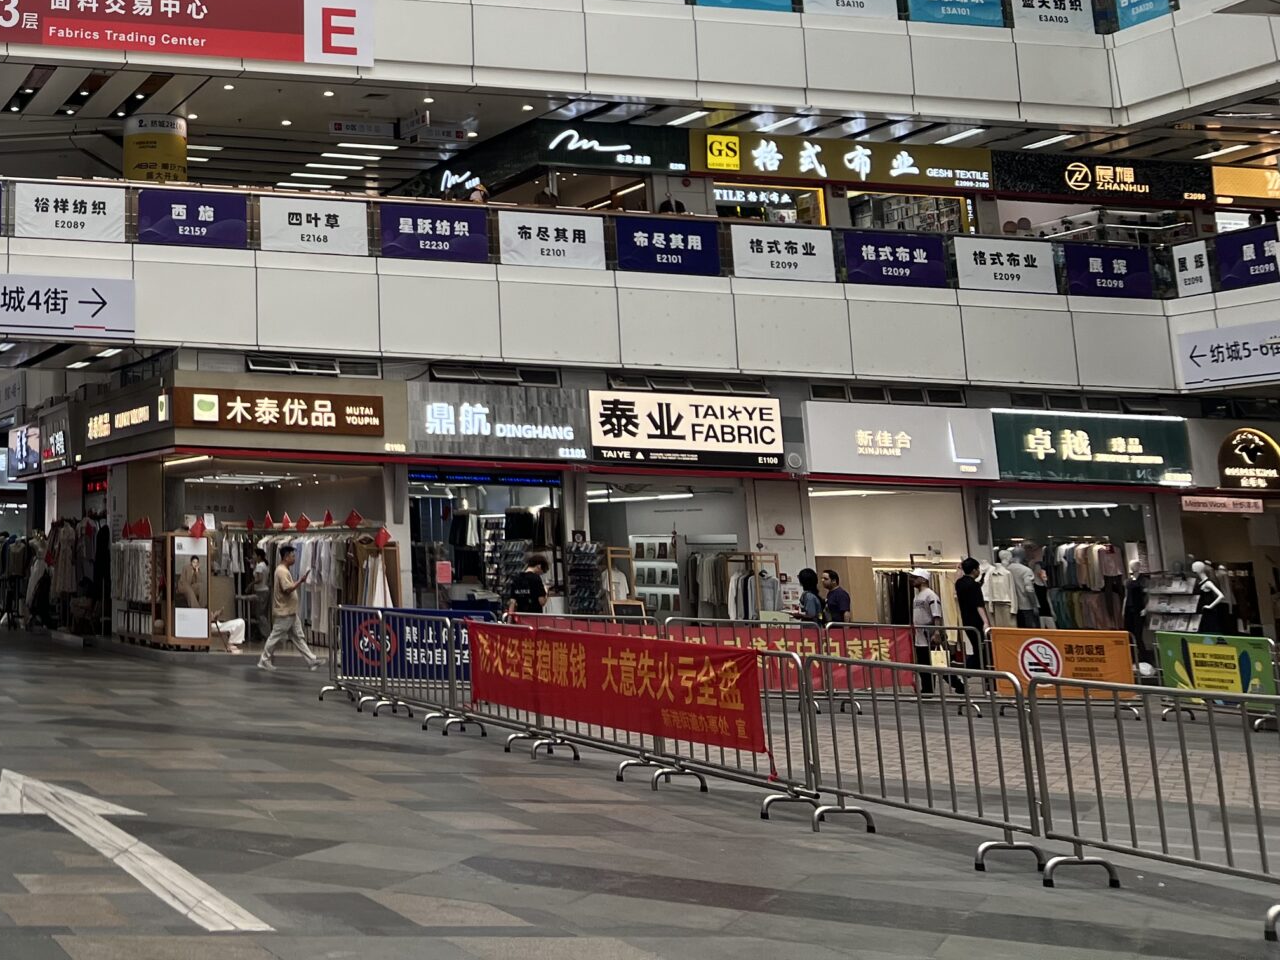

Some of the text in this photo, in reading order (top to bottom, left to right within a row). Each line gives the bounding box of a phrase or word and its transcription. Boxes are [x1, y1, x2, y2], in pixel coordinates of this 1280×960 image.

[1038, 13, 1069, 24] E3A103
[49, 25, 207, 47] Fabrics Trading Center
[321, 7, 358, 55] E
[708, 139, 738, 158] GS
[955, 170, 989, 181] TEXTILE
[1096, 180, 1149, 193] ZHANHUI
[171, 204, 215, 222] 西施
[287, 211, 340, 229] 四叶草
[55, 218, 85, 230] E2089
[178, 225, 207, 236] E2159
[398, 217, 471, 237] 星跃纺织
[300, 232, 328, 243] E2168
[517, 225, 587, 244] 布尽其用
[633, 232, 702, 251] 布尽其用
[417, 239, 450, 251] E2230
[540, 247, 566, 257] E2101
[749, 239, 817, 257] 格式布业
[861, 244, 928, 263] 格式布业
[656, 253, 682, 264] E2101
[770, 260, 799, 270] E2099
[973, 250, 1038, 269] 格式布业
[1089, 257, 1127, 273] 展辉
[1178, 253, 1205, 272] 展辉
[882, 266, 910, 276] E2099
[993, 272, 1021, 282] E2099
[1096, 278, 1124, 288] E2098
[226, 396, 336, 428] 木泰优品
[345, 406, 373, 415] MUTAI
[425, 402, 491, 436] 鼎航
[599, 398, 686, 440] 泰业
[345, 415, 379, 426] YOUPIN
[496, 423, 574, 440] DINGHANG
[691, 423, 776, 445] FABRIC
[1025, 428, 1093, 461] 卓越
[601, 646, 745, 712] 大意失火亏全盘
